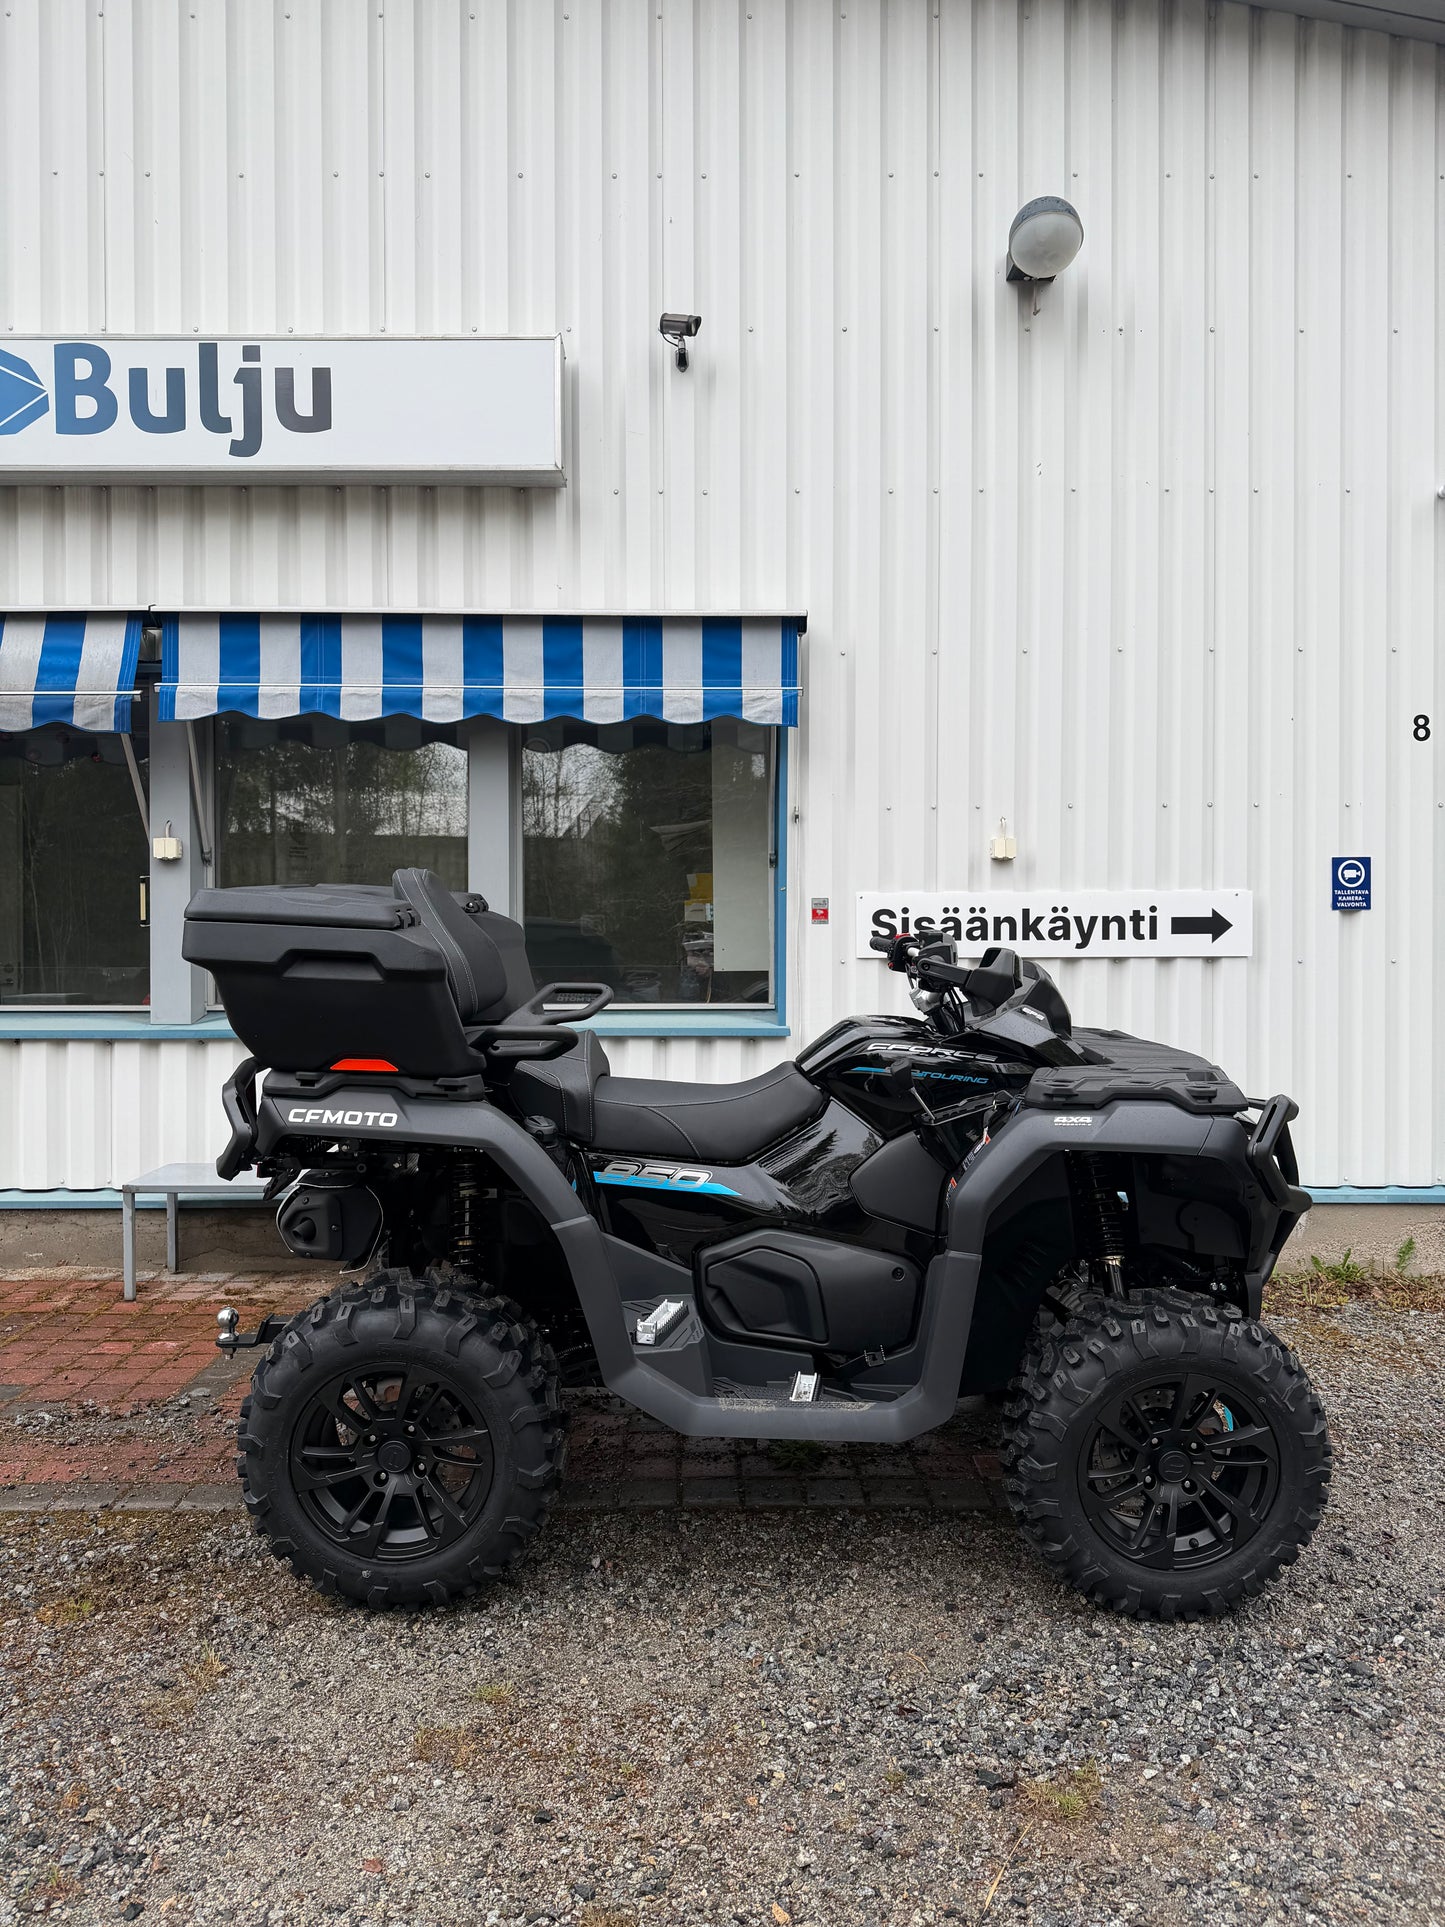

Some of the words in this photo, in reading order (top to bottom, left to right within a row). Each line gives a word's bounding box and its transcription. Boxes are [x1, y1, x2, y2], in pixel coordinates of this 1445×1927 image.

[54, 342, 332, 458] Bulju
[1413, 714, 1431, 741] 8
[870, 905, 1158, 949] Sisäänkäynti
[867, 1042, 998, 1062] CFORCE
[921, 1071, 989, 1084] TOURING
[288, 1108, 398, 1127] CFMOTO
[598, 1160, 713, 1188] 850
